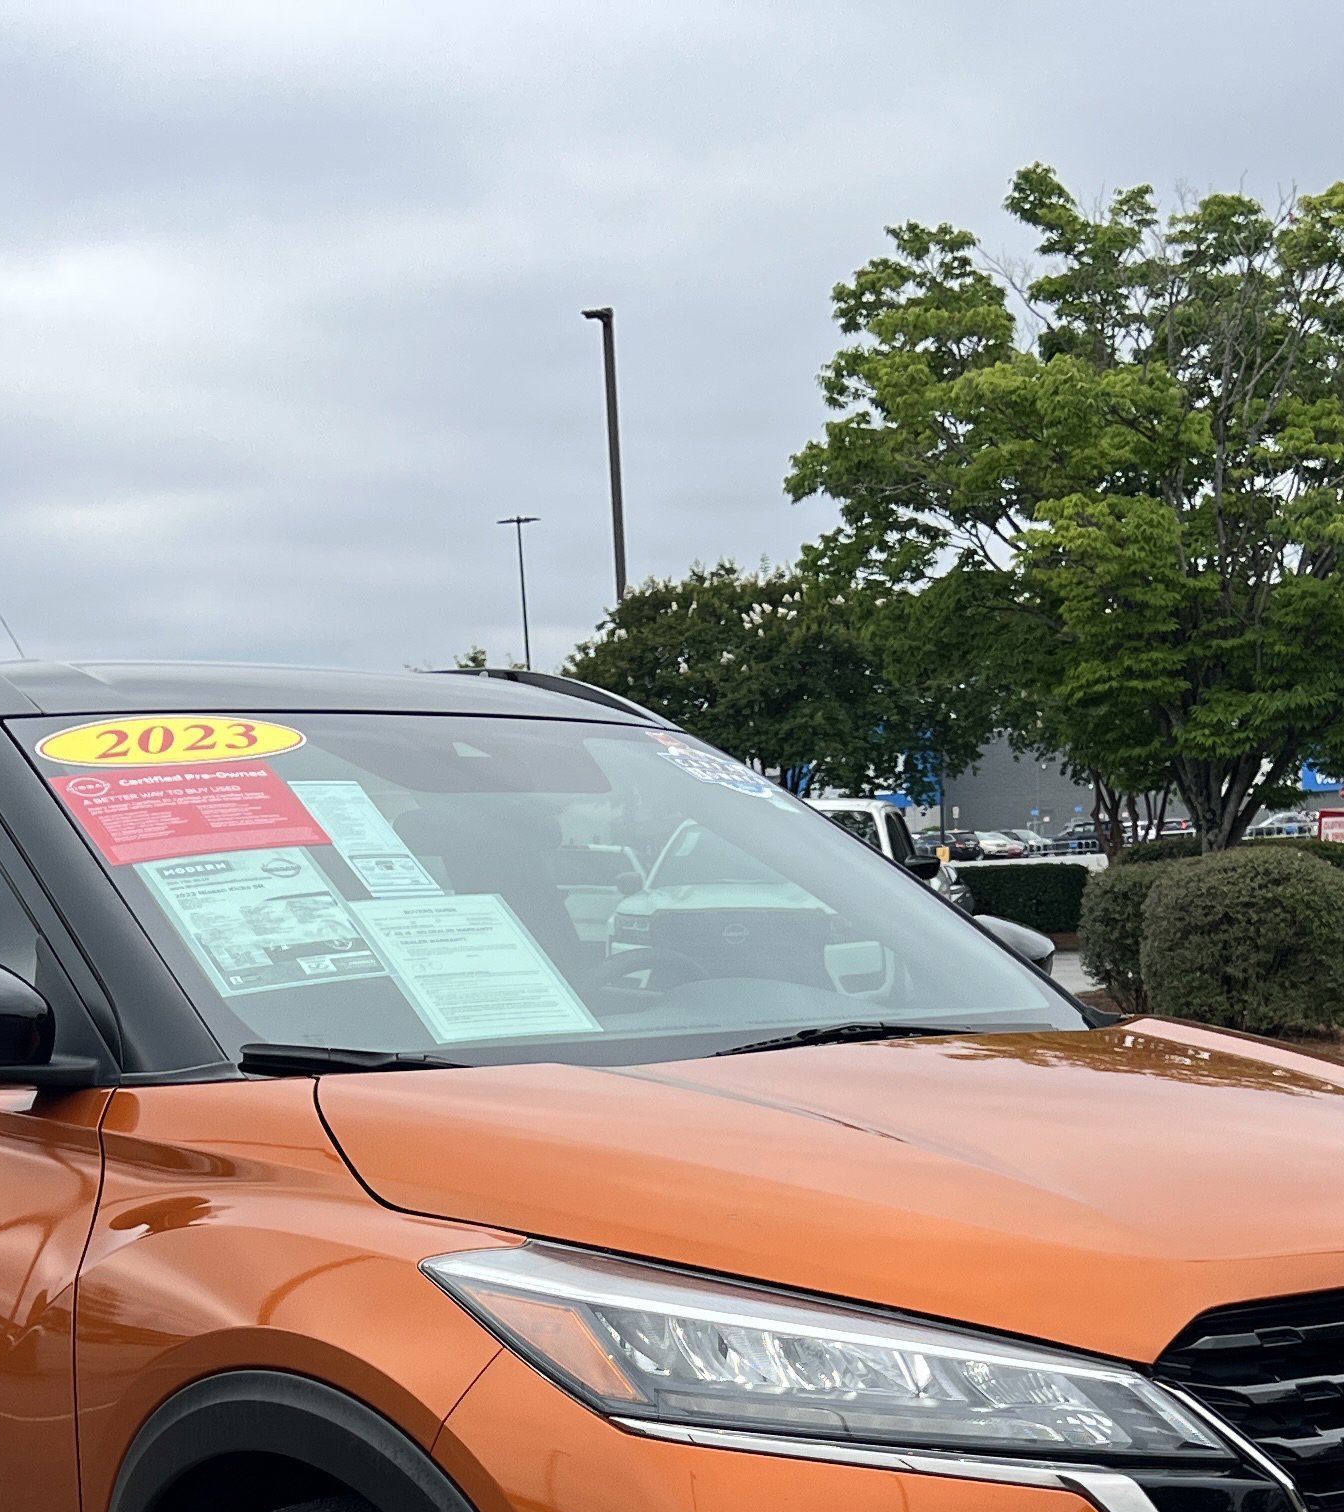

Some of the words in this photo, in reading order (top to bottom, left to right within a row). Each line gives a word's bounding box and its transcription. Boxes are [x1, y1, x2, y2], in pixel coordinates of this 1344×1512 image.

[95, 723, 258, 760] 2023
[118, 774, 183, 787] Certified
[184, 770, 268, 781] Pre-Owned
[93, 793, 139, 805] BETTER
[163, 862, 226, 876] MODERN
